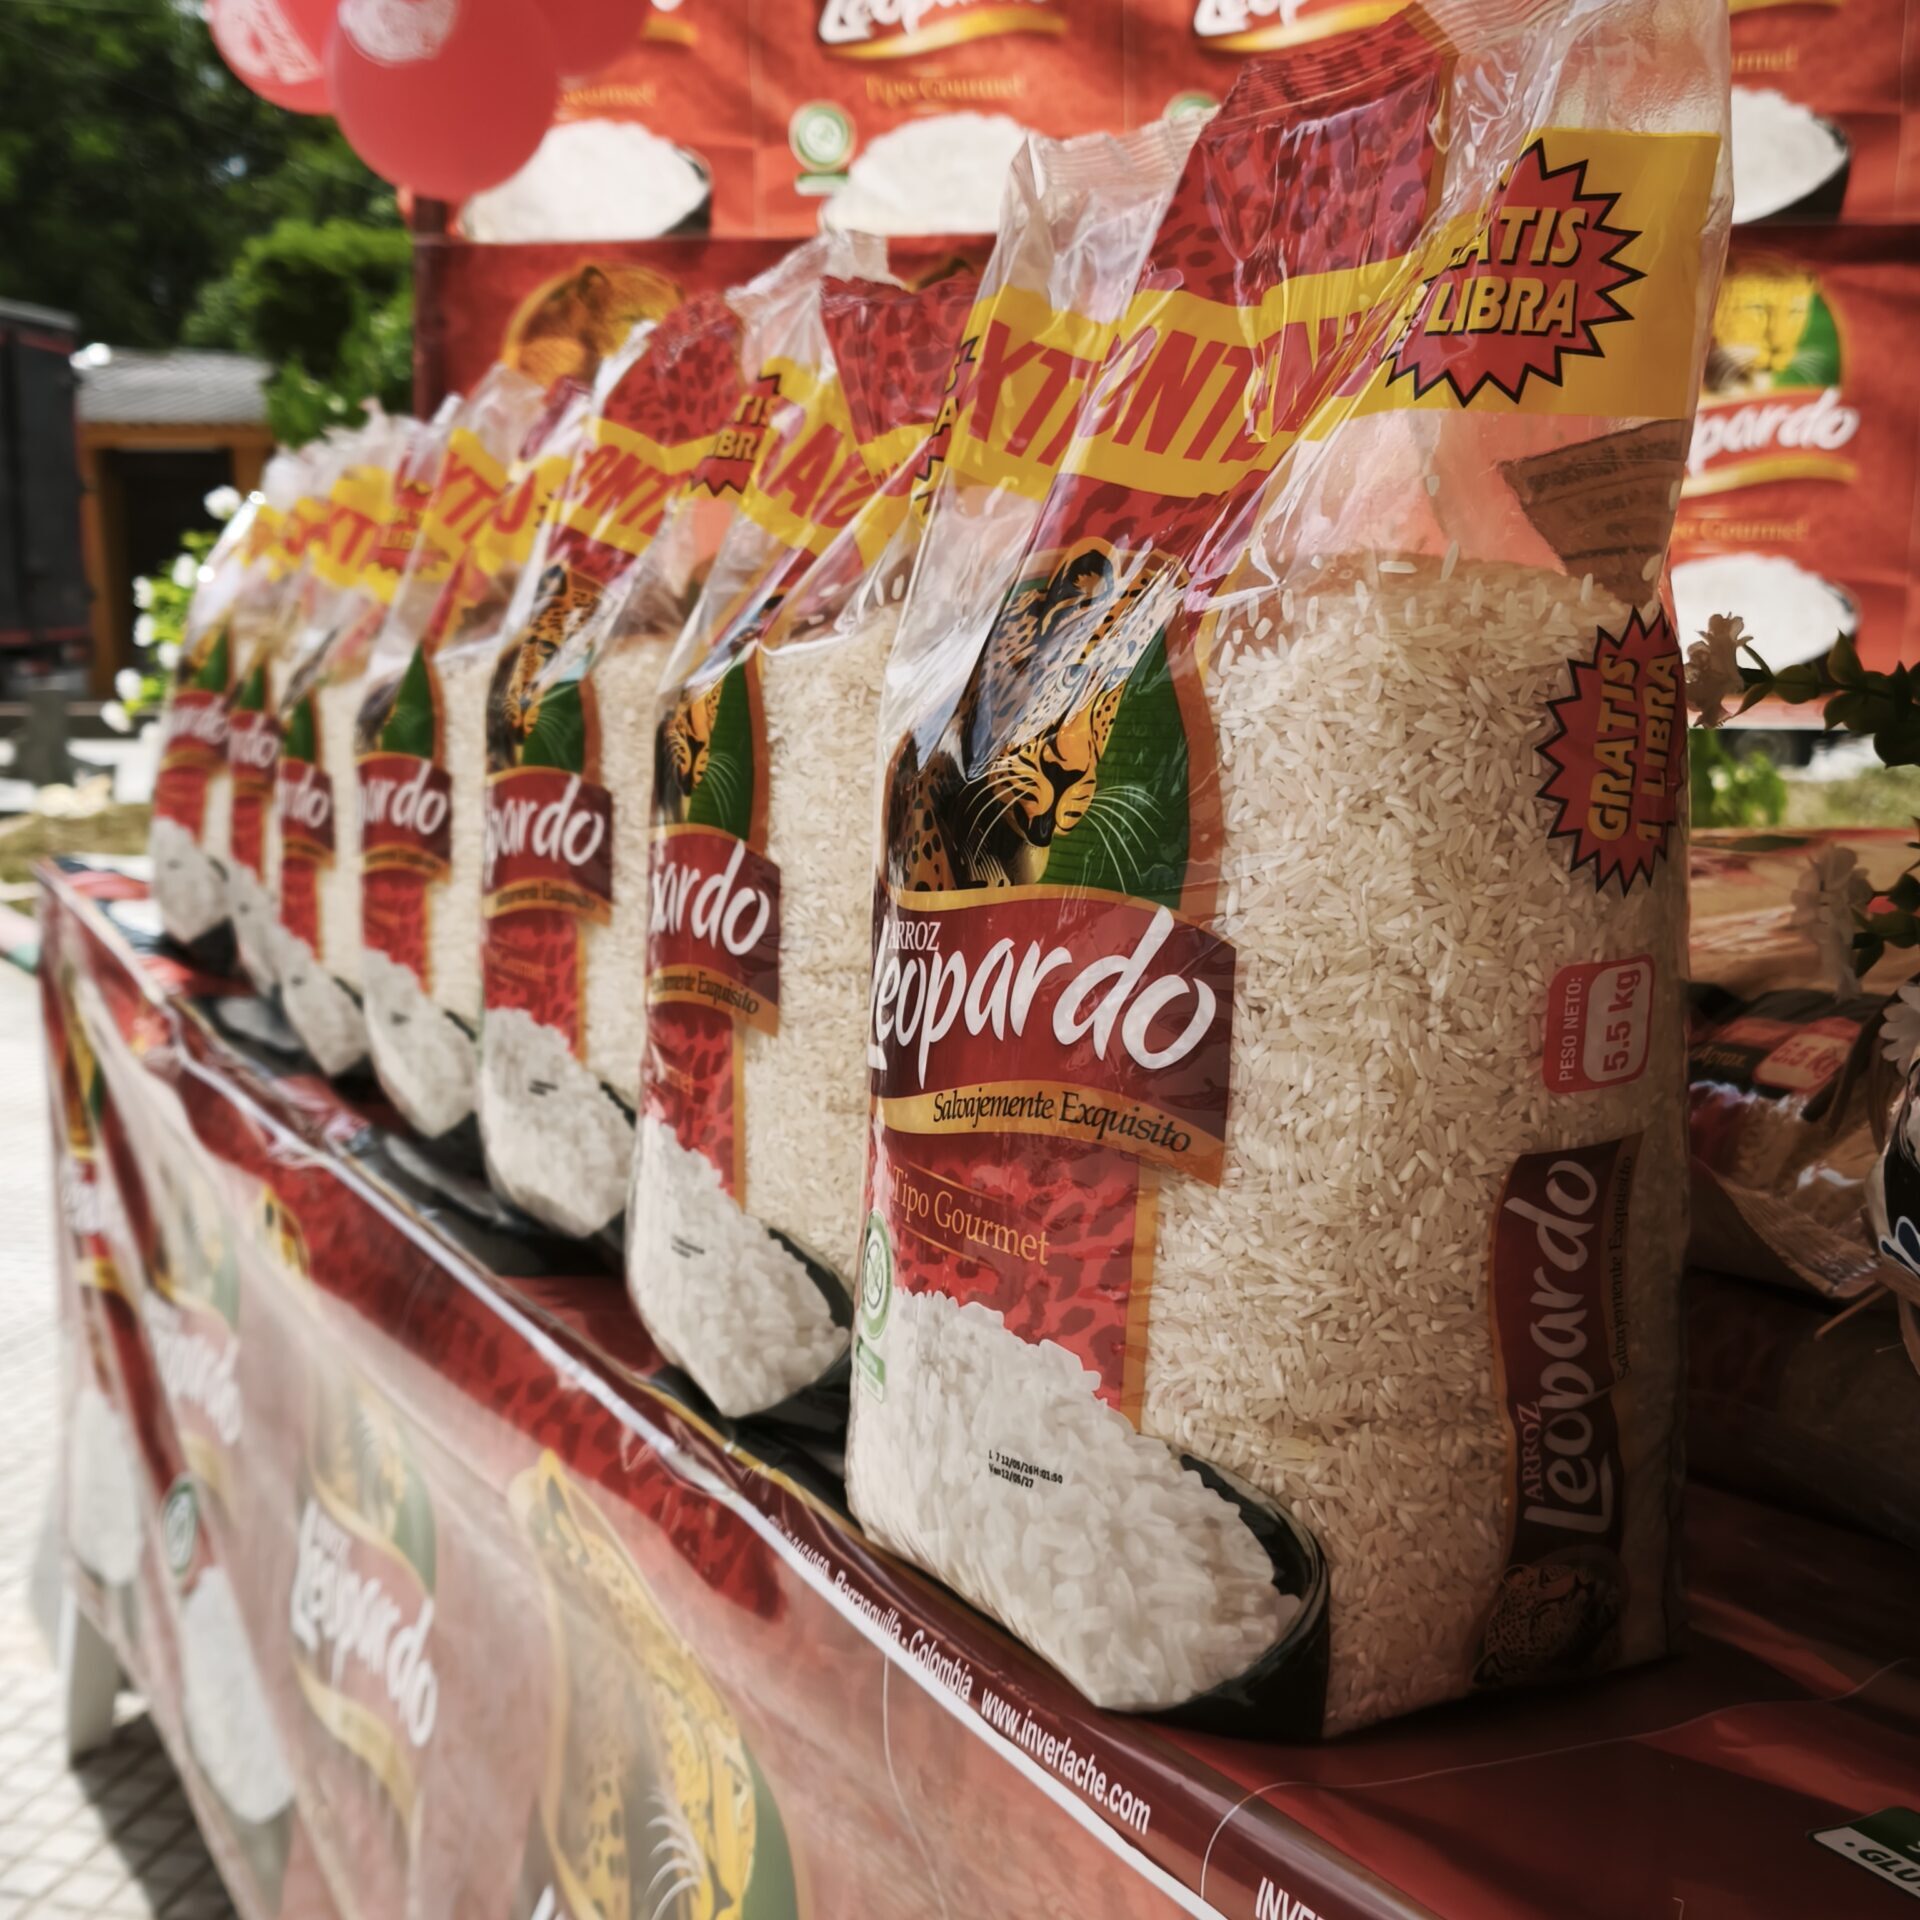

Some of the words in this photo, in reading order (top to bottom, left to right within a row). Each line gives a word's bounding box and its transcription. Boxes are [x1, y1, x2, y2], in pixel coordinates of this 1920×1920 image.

[1423, 275, 1579, 338] LIBRA
[1587, 653, 1640, 842] GRATIS
[1641, 651, 1681, 798] LIBRA
[1636, 818, 1662, 842] 1
[888, 920, 942, 951] ARROZ
[1562, 977, 1583, 1030] NETO:
[1607, 969, 1642, 1014] kg
[1558, 1034, 1577, 1082] PESO
[1602, 1020, 1632, 1073] 5.5
[933, 1087, 1055, 1128] Salvajemente
[1059, 1091, 1192, 1153] Exquisito
[891, 1165, 930, 1223] Tipo
[934, 1191, 1051, 1266] Gourmet
[1503, 1158, 1619, 1535] Leopardo
[1516, 1401, 1545, 1503] ARROZ
[908, 1629, 973, 1702] Colombia
[980, 1687, 1152, 1836] www.inverlache.com
